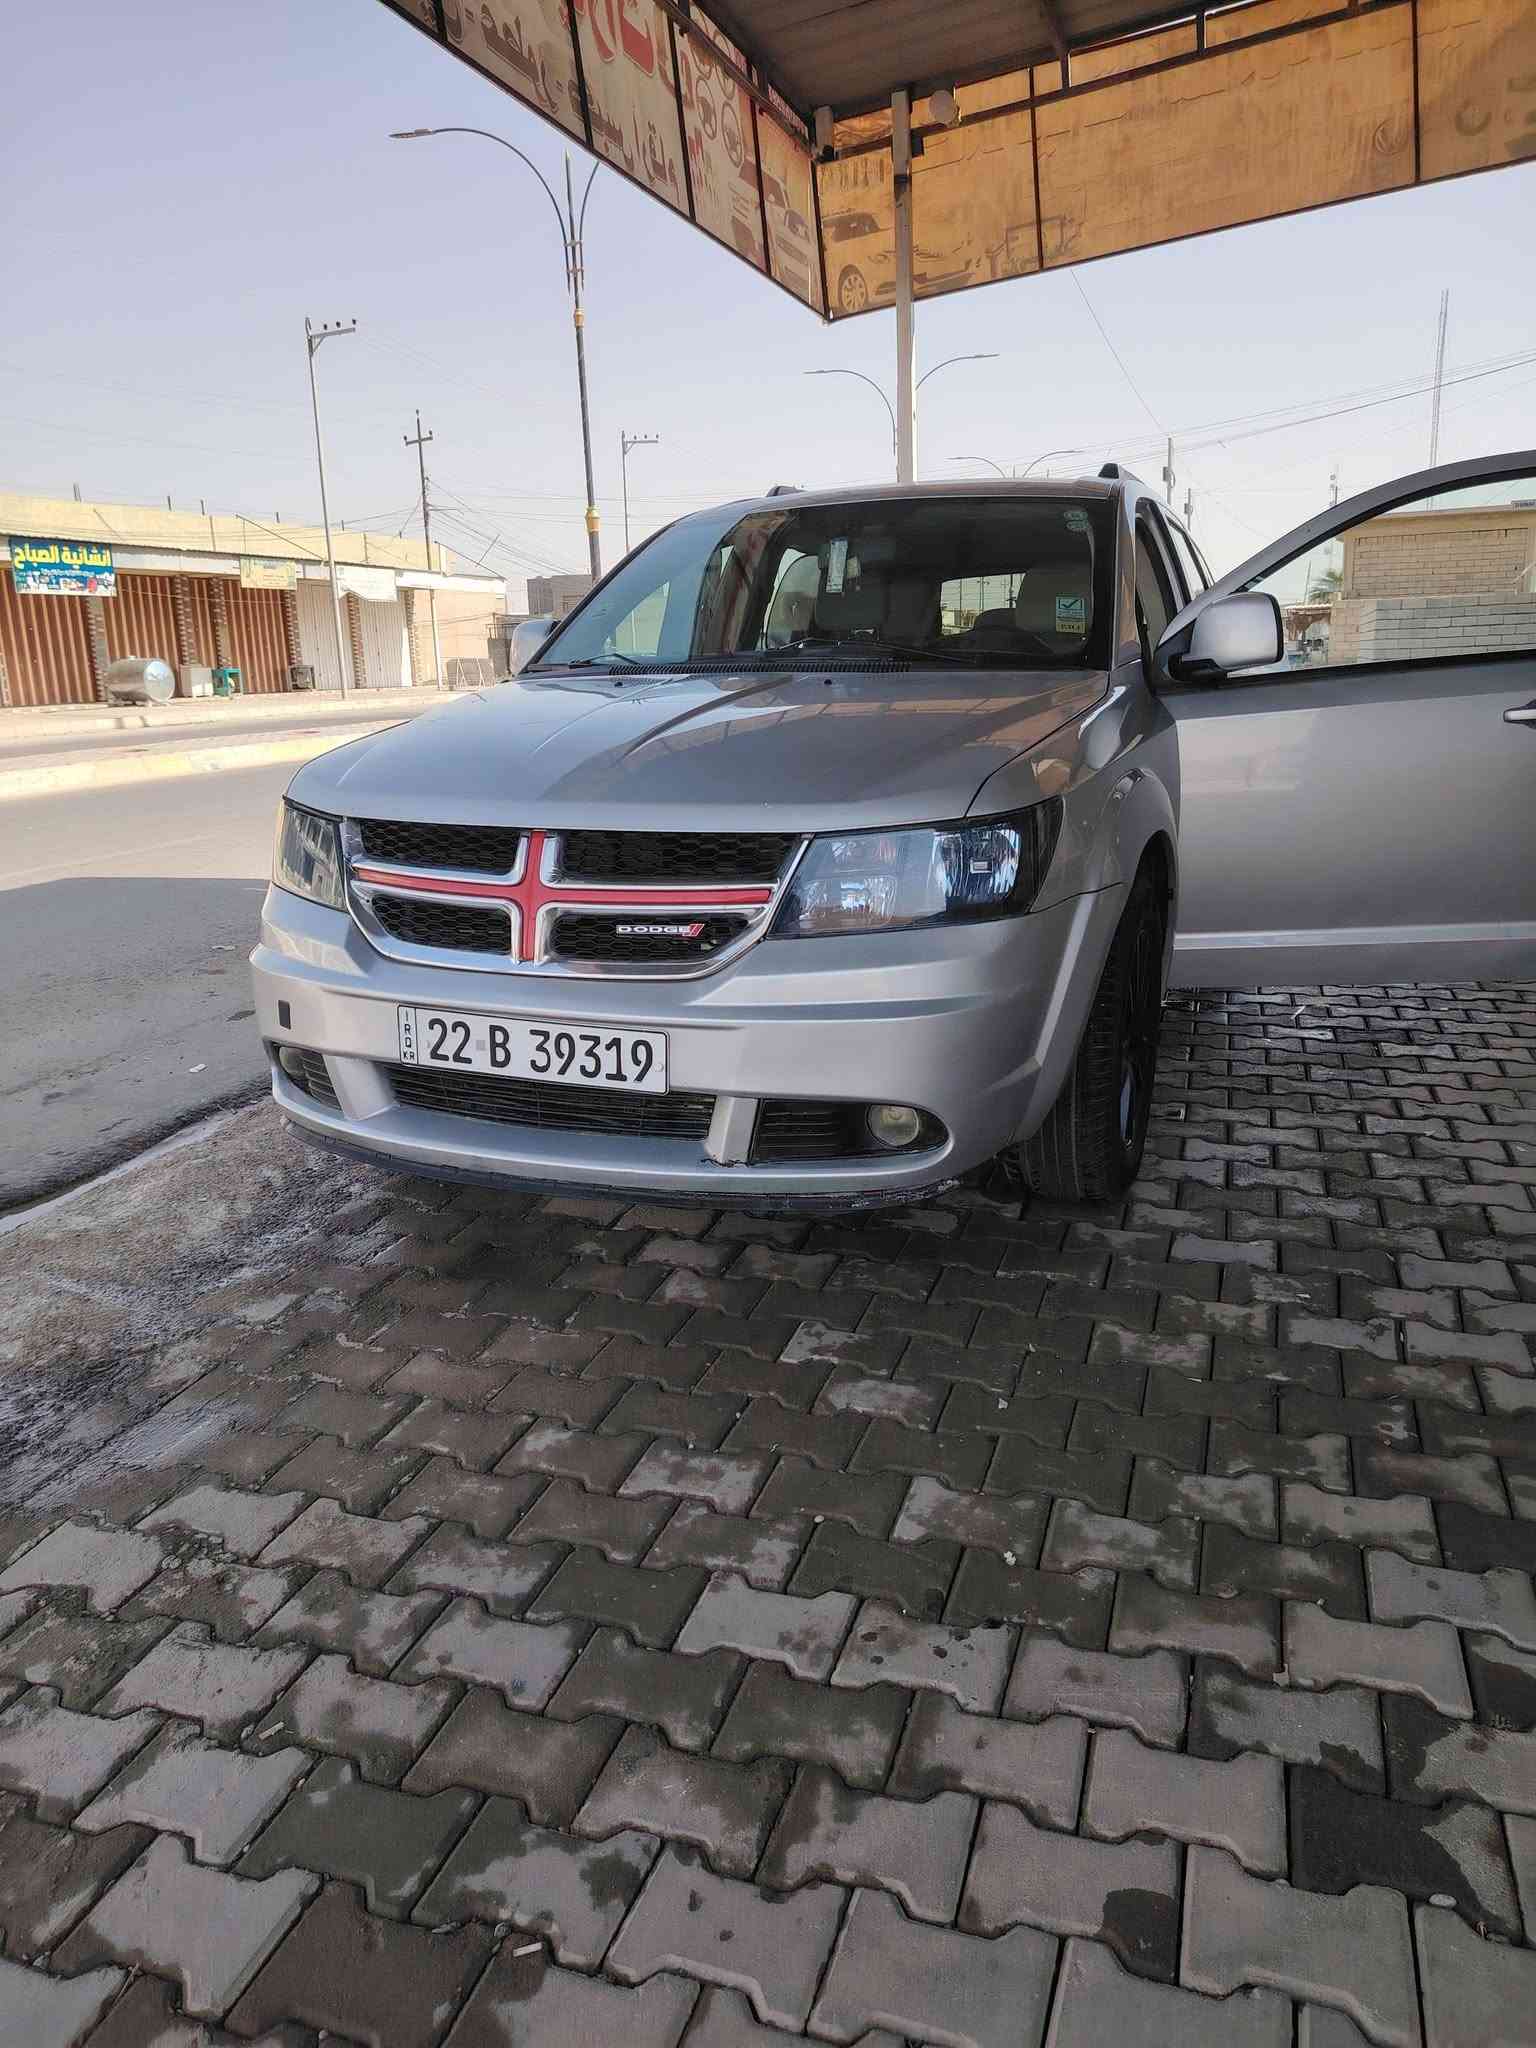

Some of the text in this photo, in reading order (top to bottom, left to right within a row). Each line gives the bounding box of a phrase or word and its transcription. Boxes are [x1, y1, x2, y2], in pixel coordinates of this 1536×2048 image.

[15, 542, 60, 569] الصباح
[617, 925, 691, 934] DODGE
[428, 1018, 653, 1082] 22 B 39319
